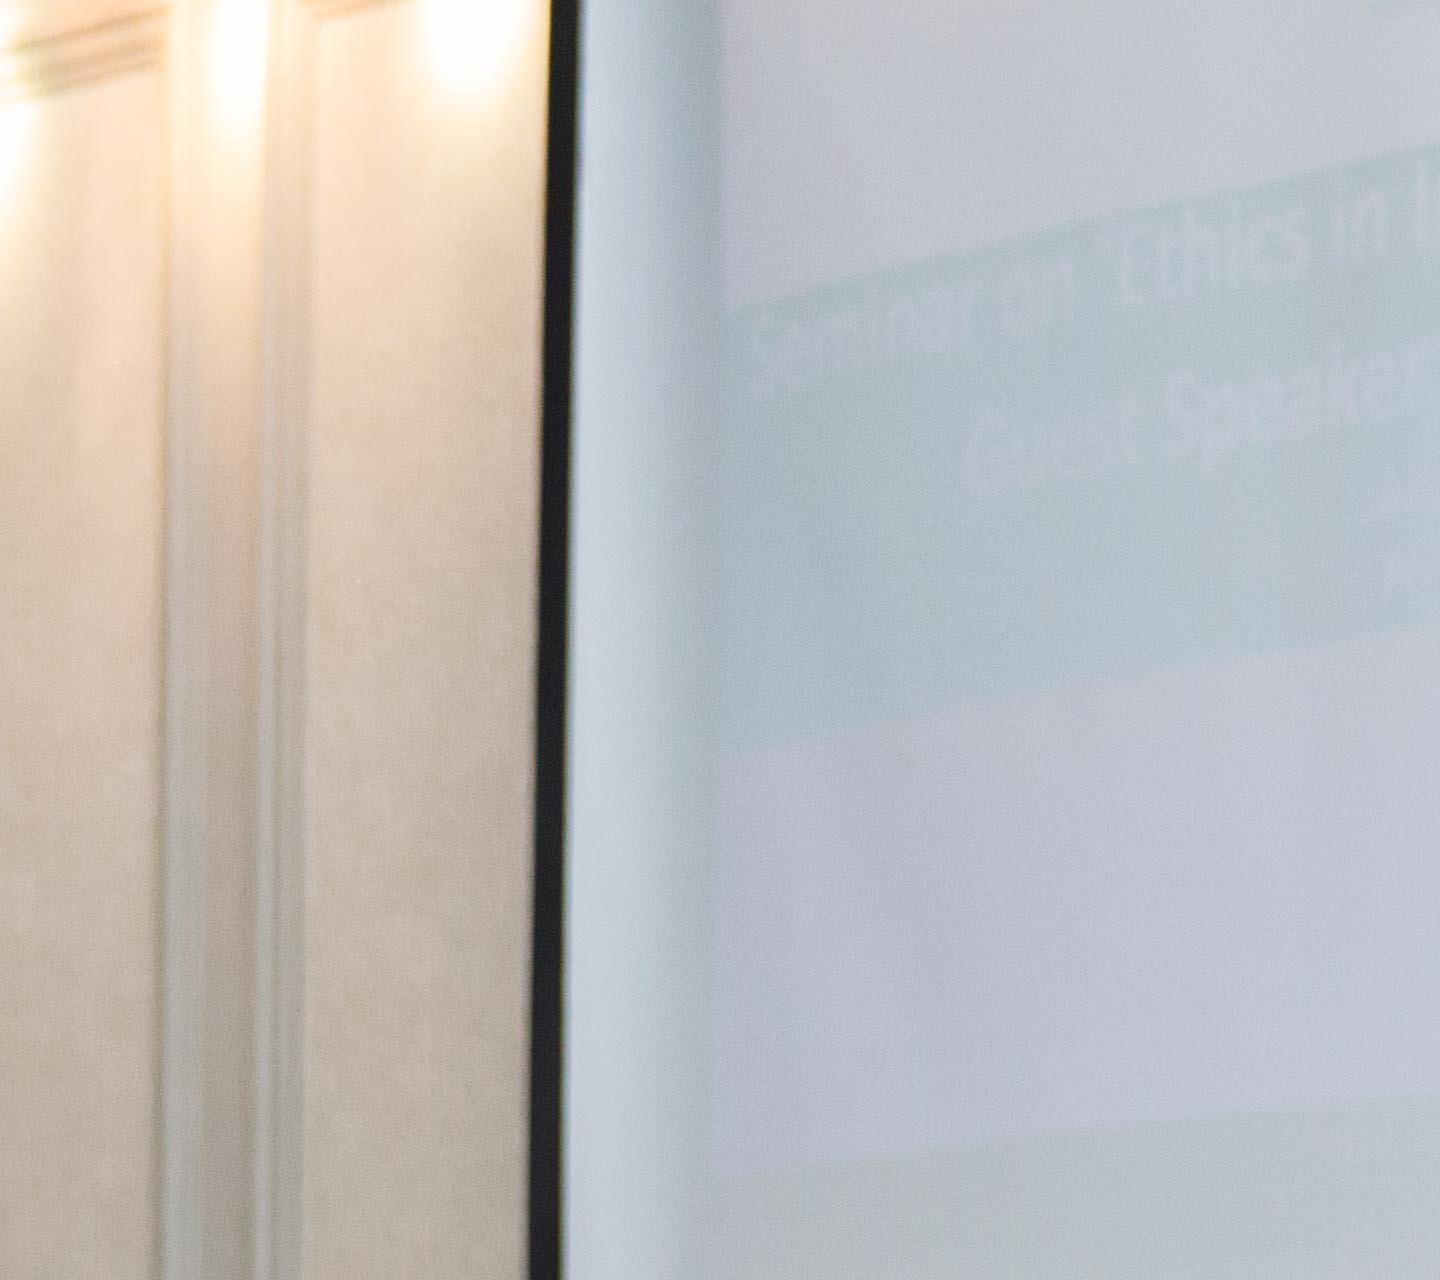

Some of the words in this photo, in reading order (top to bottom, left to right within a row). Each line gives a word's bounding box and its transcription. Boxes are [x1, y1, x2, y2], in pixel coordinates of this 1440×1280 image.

[992, 260, 1073, 336] on
[1325, 170, 1388, 262] in
[959, 382, 1139, 496] Guest
